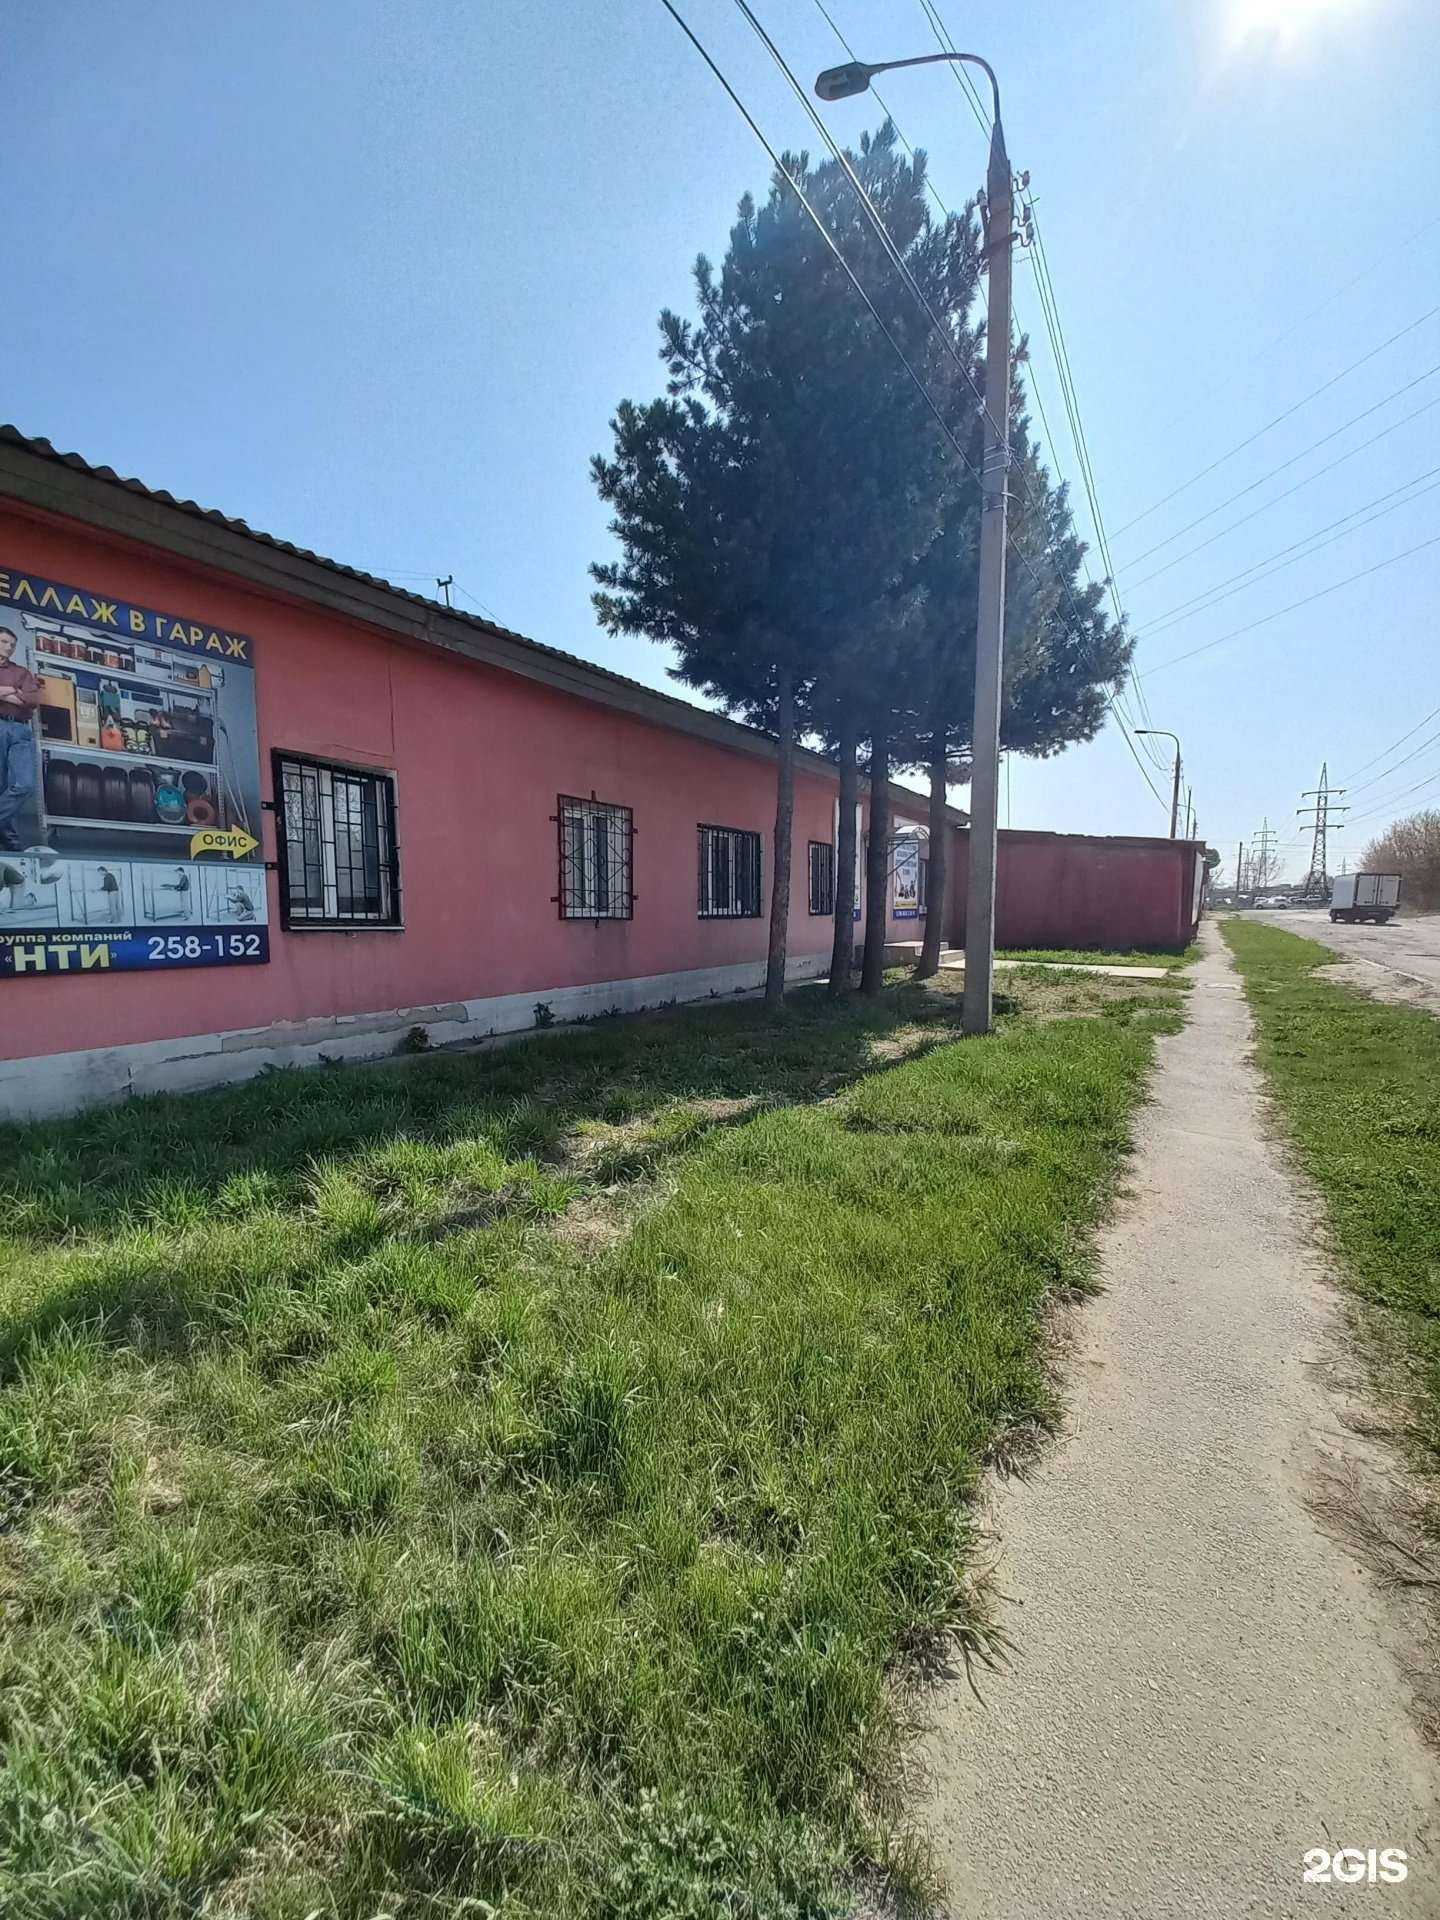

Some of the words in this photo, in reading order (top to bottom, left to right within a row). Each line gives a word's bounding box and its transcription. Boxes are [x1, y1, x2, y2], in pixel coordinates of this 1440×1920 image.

[129, 610, 146, 632] В
[156, 617, 247, 660] ГАРАЖ
[202, 832, 247, 848] ОФИС
[52, 931, 133, 943] компаний
[147, 934, 261, 960] 258-152
